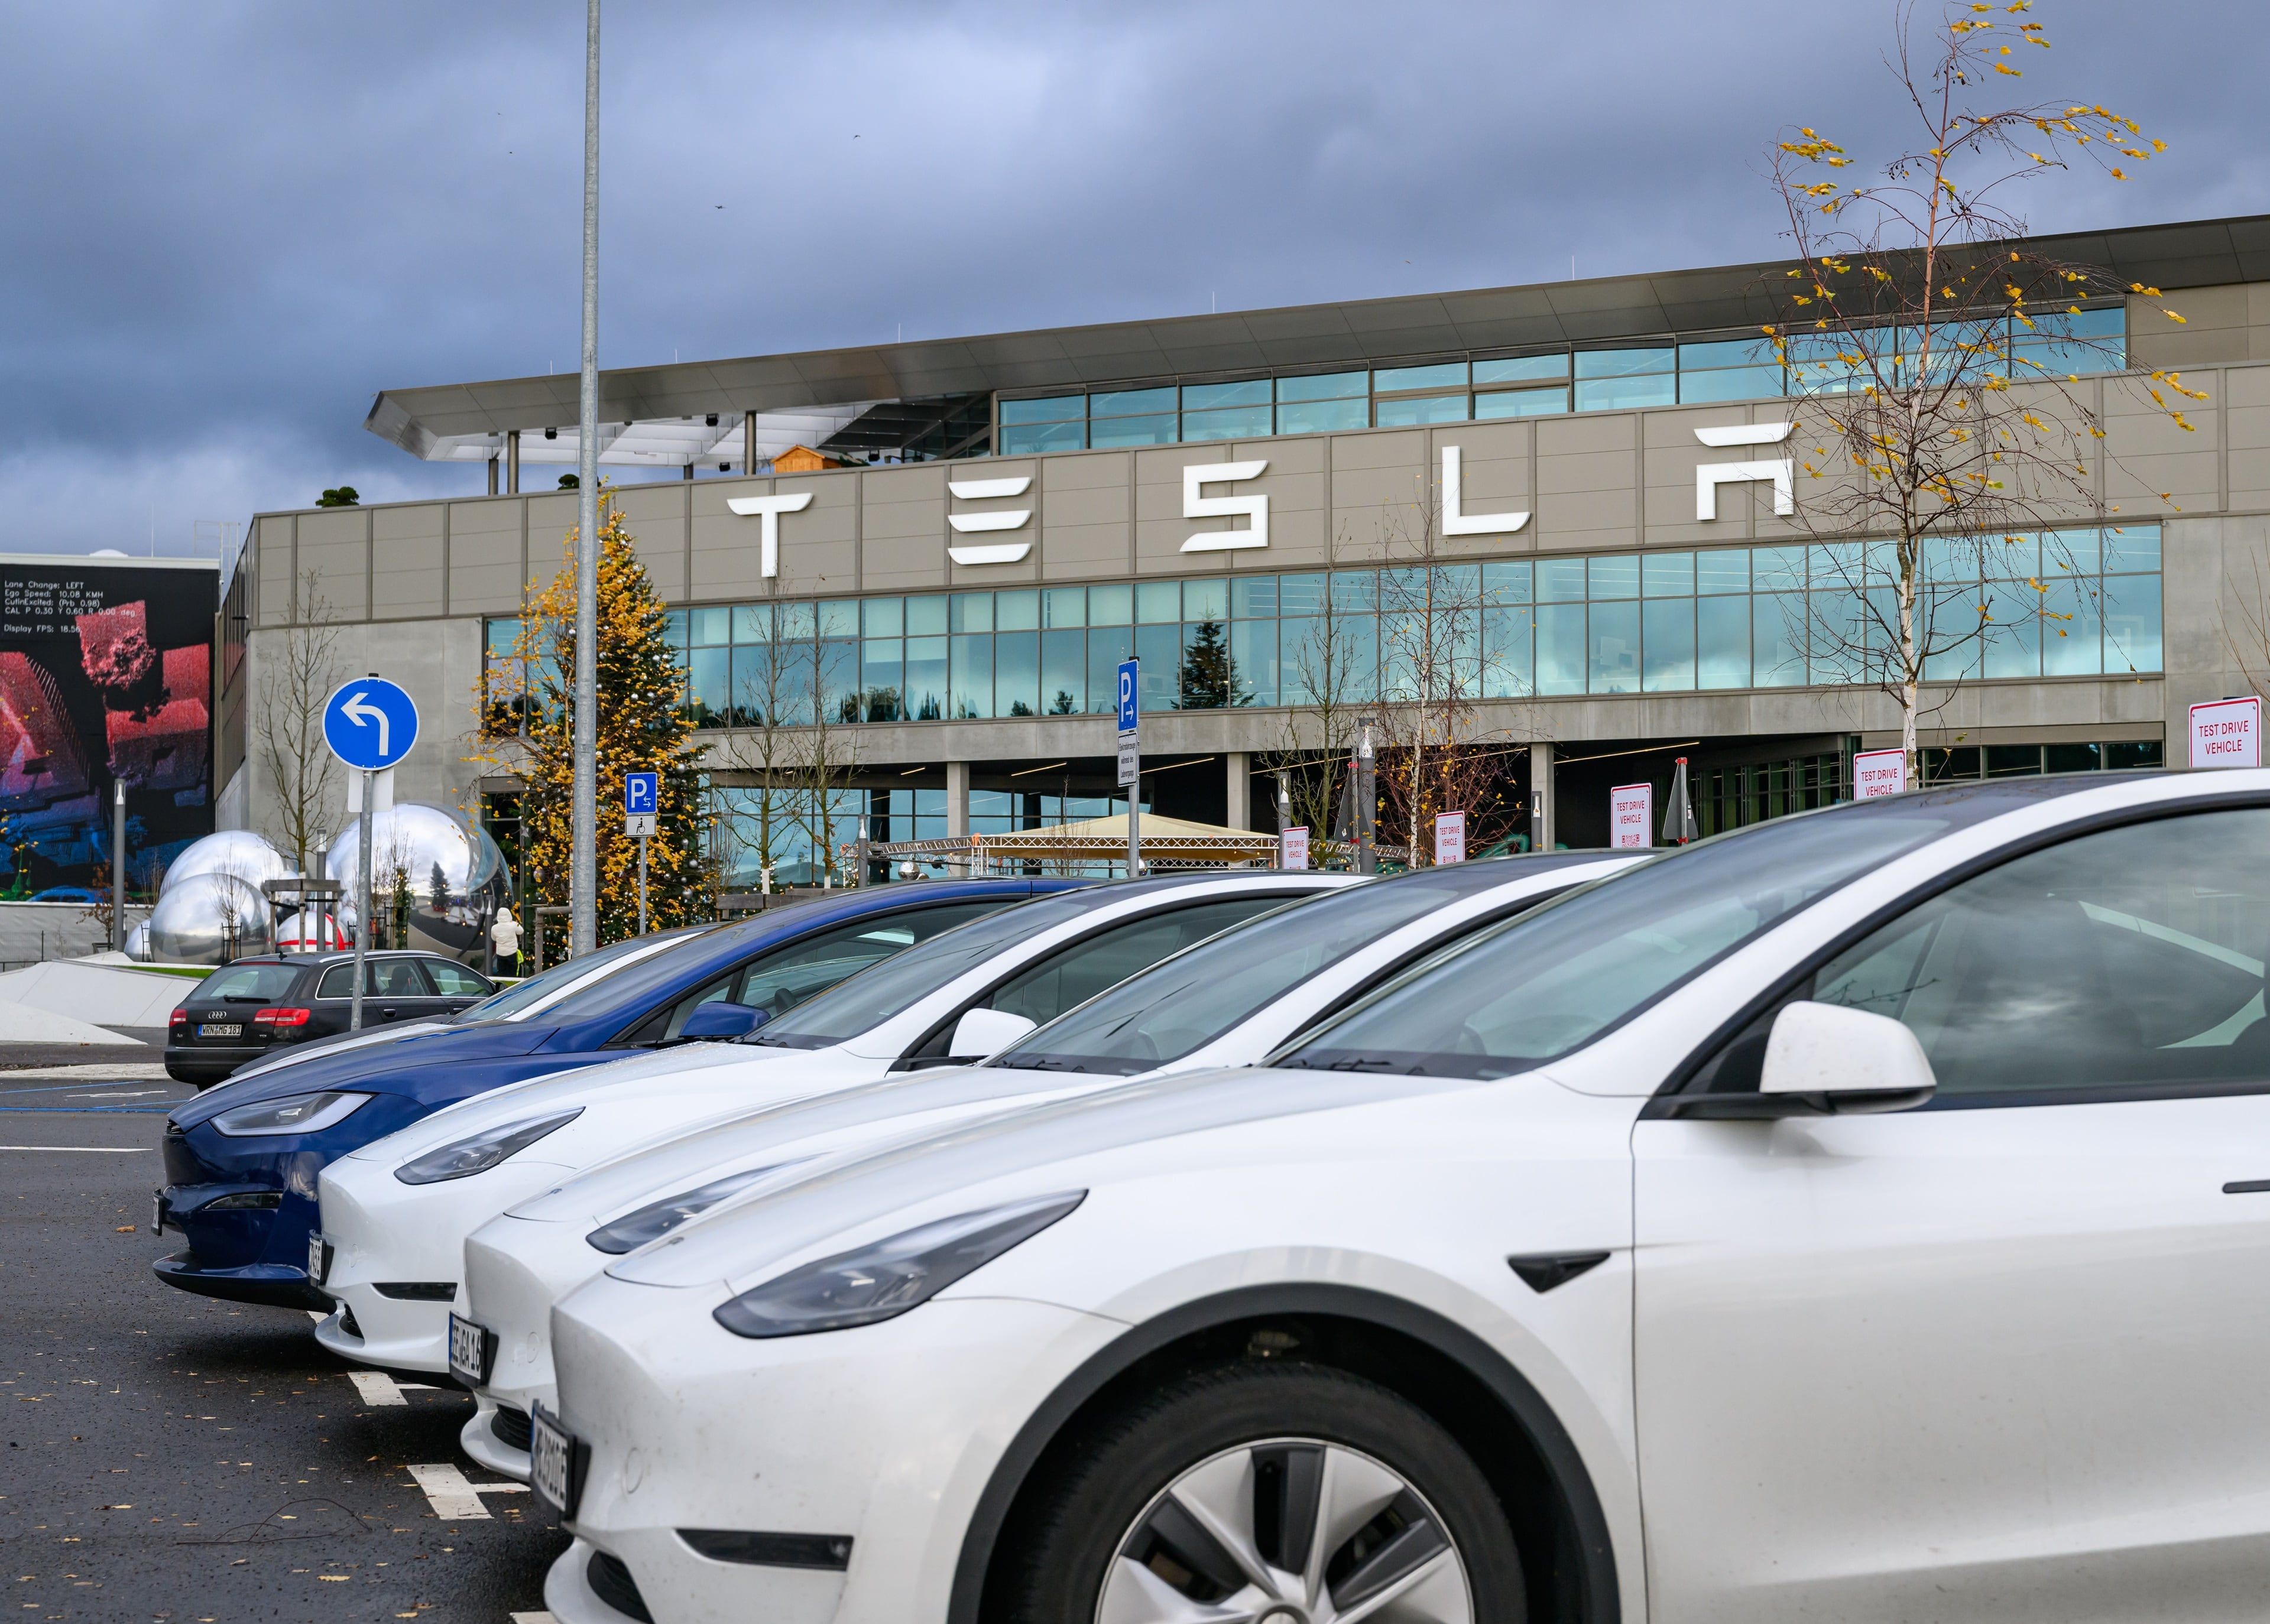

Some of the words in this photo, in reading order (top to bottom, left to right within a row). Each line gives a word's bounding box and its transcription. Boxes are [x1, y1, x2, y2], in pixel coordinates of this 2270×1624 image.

[727, 422, 1795, 577] TESLA
[28, 580, 60, 590] Change:
[5, 590, 20, 598] Ego
[24, 589, 51, 598] Speed:
[59, 599, 75, 608] (Prb
[80, 599, 100, 608] 0.98)
[121, 609, 135, 618] deg
[4, 624, 32, 634] Display
[37, 625, 54, 633] FPS:
[1121, 672, 1131, 722] P
[2199, 724, 2219, 738] TEST
[2222, 720, 2249, 735] DRIVE
[2205, 739, 2242, 755] VEHICLE
[1862, 771, 1876, 781] TEST
[1877, 768, 1898, 779] DRIVE
[631, 779, 647, 808] P
[1866, 784, 1893, 796] VEHICLE
[1617, 802, 1628, 811] TEST
[1630, 800, 1645, 810] DRIVE
[1620, 814, 1641, 824] VEHICLE
[1448, 826, 1460, 834] DRIVE
[1442, 838, 1457, 846] VEHICLE
[202, 1025, 215, 1034] WRN
[219, 1025, 227, 1034] MG
[228, 1025, 241, 1034] 181
[471, 1333, 481, 1372] 16
